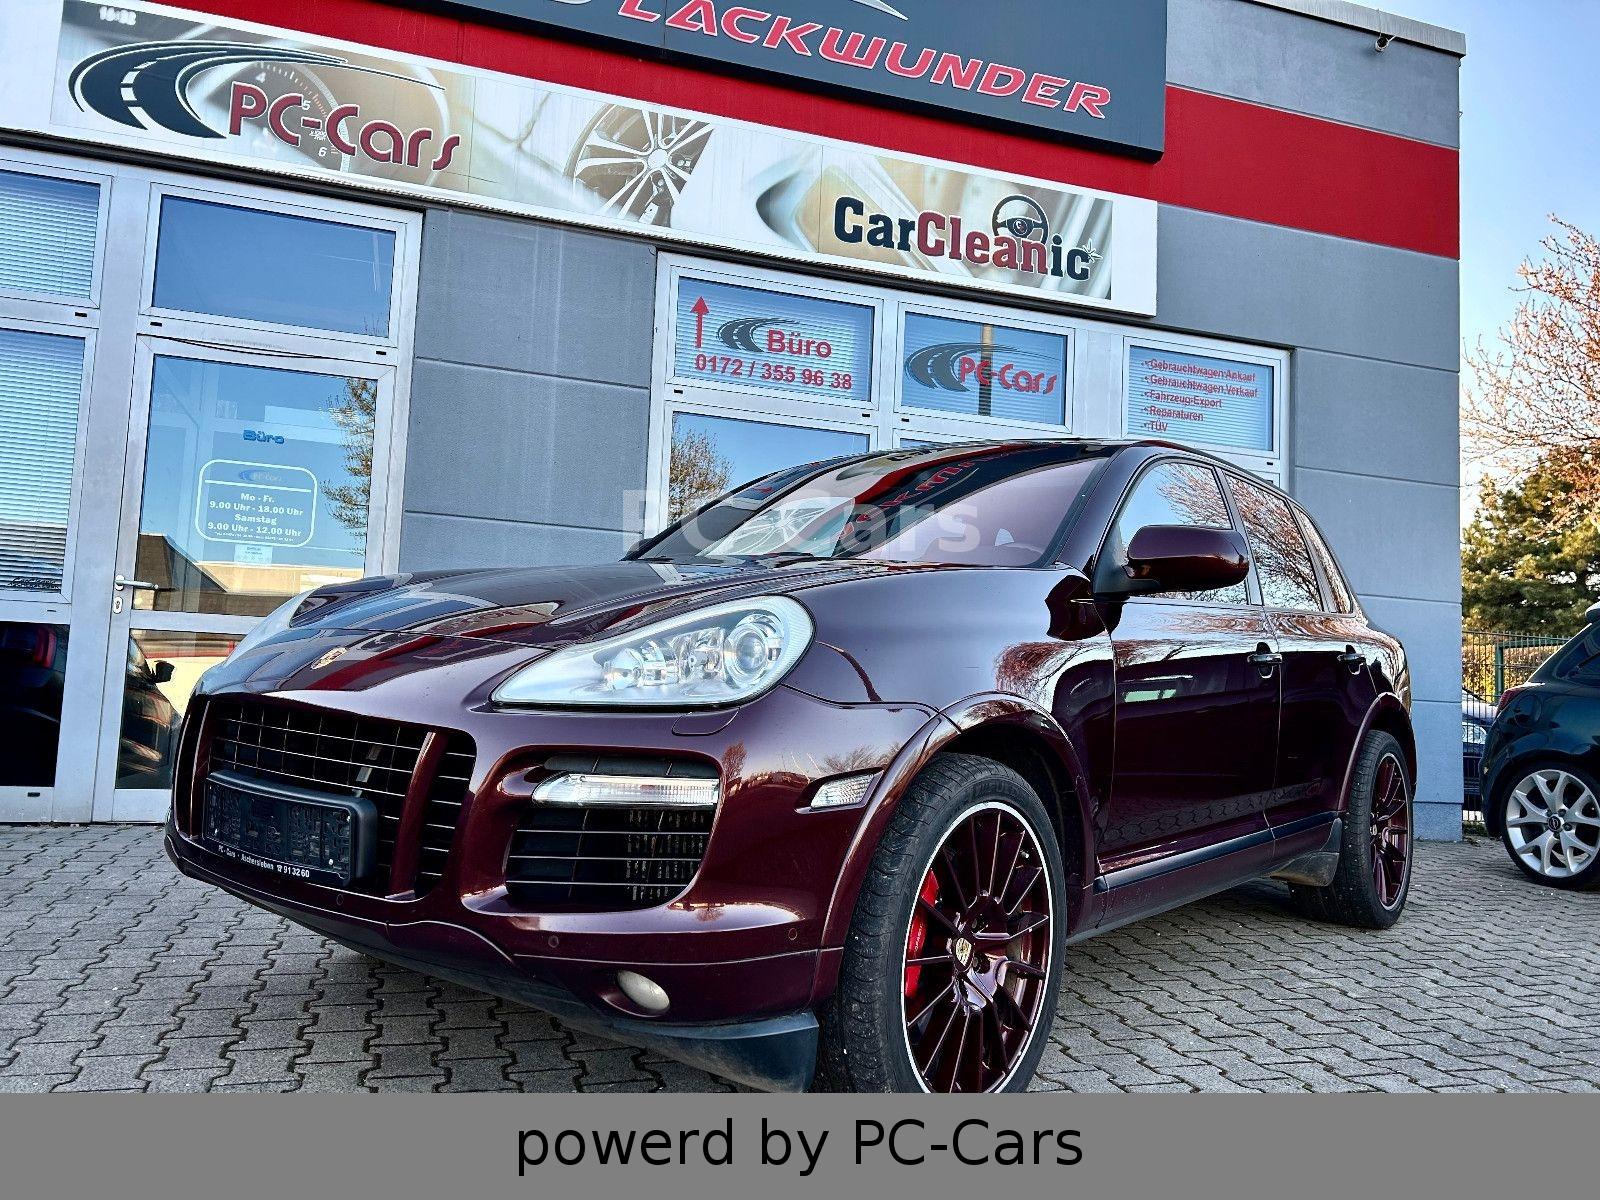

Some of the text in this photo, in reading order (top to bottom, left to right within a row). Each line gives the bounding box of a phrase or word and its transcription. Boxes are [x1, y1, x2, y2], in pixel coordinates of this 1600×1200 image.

[229, 81, 461, 171] PC-Cars
[833, 196, 1092, 281] CarCleanic
[767, 329, 832, 359] Büro
[695, 353, 852, 390] 0172 / 355 96 38
[958, 356, 1058, 395] PC-Cars
[1149, 405, 1204, 421] Reparaturen
[1149, 420, 1168, 432] TÜV
[243, 430, 285, 445] Büro
[240, 492, 255, 502] Mo
[262, 494, 275, 503] Fr.
[209, 500, 231, 509] 9.00
[233, 501, 250, 511] Uhr
[258, 505, 285, 514] 18.00
[287, 507, 304, 516] Uhr
[234, 513, 278, 526] Samstag
[207, 522, 229, 531] 9.00
[231, 523, 249, 532] Uhr
[256, 526, 283, 535] 12.00
[284, 528, 302, 537] Uhr
